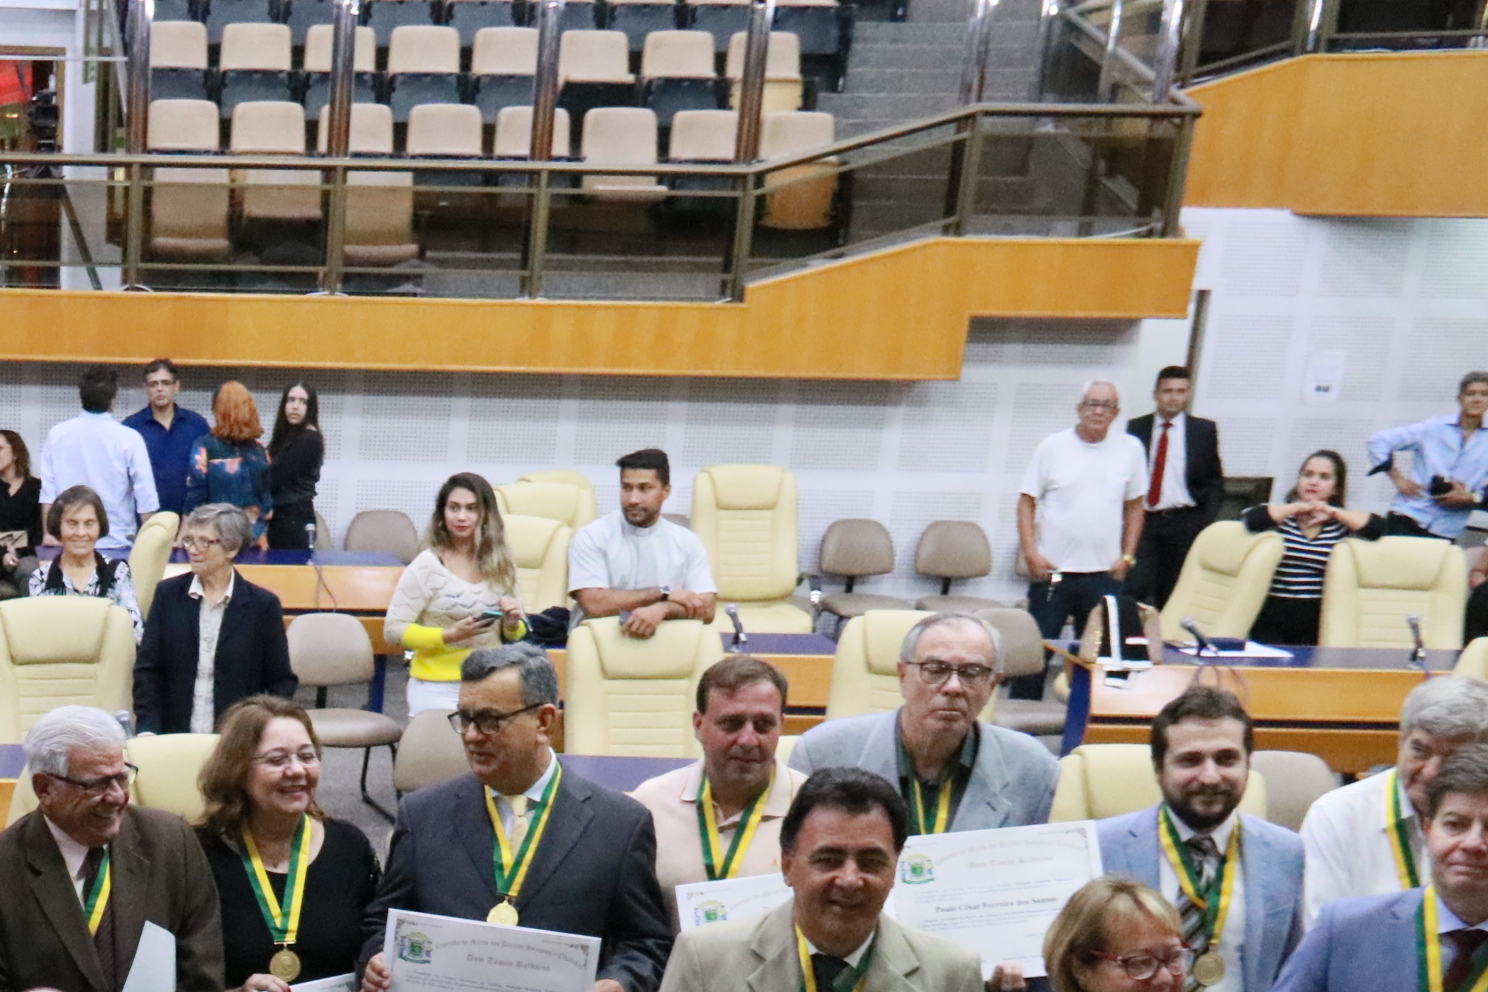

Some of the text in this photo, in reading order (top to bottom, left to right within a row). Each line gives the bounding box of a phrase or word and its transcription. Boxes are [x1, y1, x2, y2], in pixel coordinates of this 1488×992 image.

[935, 905, 956, 913] Paulo
[983, 900, 1014, 909] Ferreira
[1032, 896, 1057, 905] Santos
